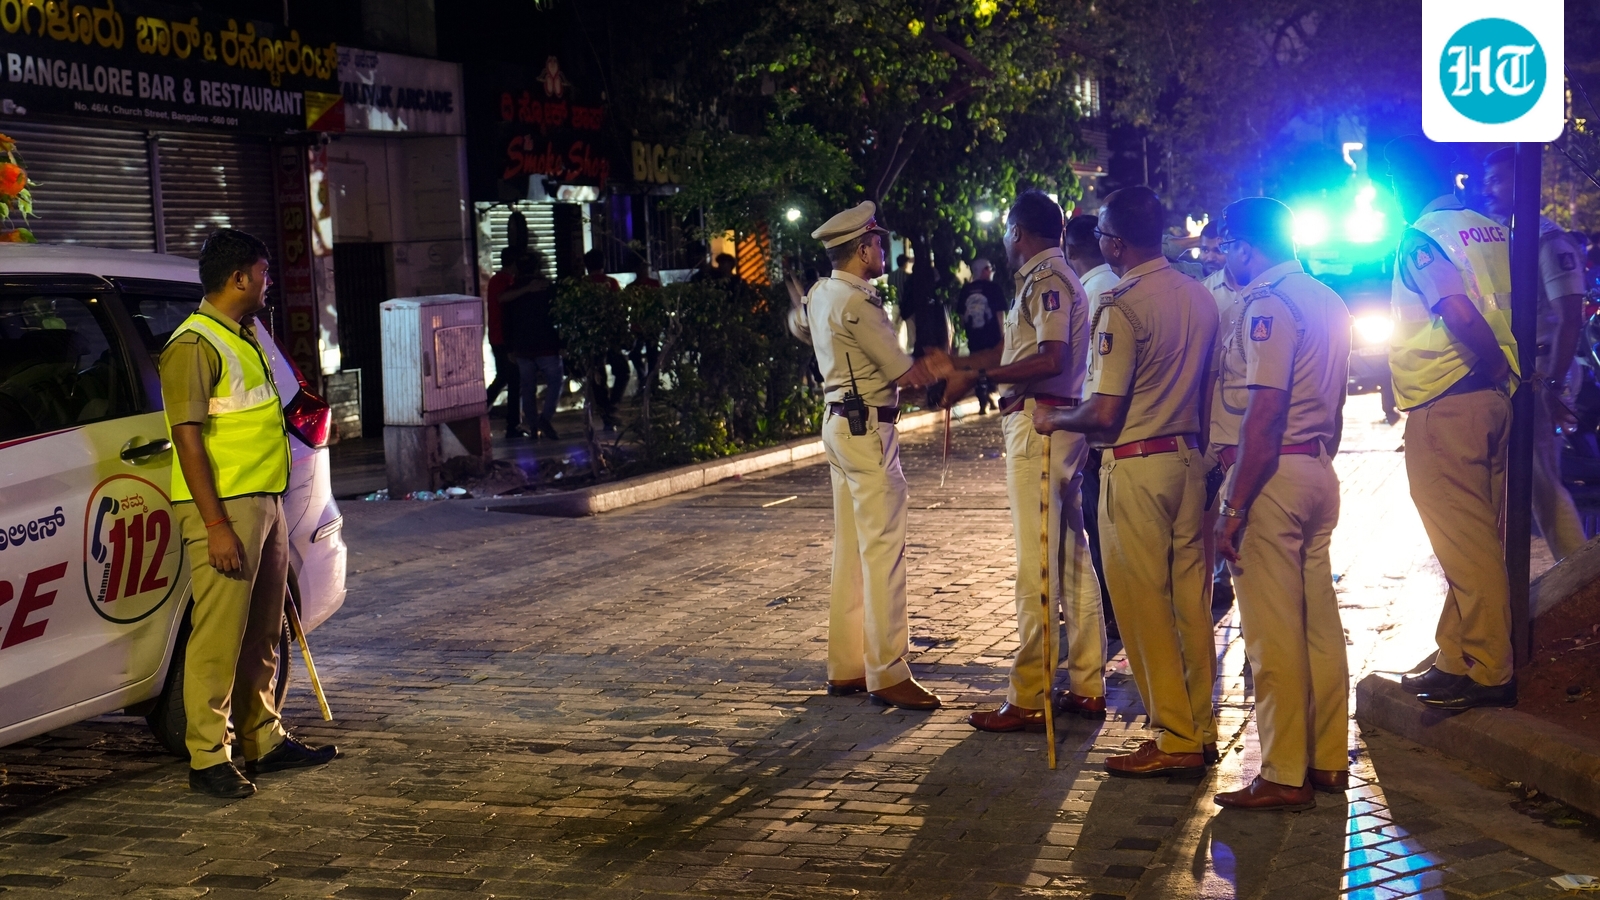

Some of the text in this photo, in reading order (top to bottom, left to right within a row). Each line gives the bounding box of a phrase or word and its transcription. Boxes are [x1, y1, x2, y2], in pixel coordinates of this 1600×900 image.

[0, 0, 126, 50] ಂಗಳೂರು
[134, 15, 200, 60] ಬಾರ್
[202, 31, 218, 62] &
[6, 52, 303, 116] BANGALORE BAR & RESTAURANT
[396, 87, 454, 114] ARCADE
[74, 101, 89, 111] No.
[112, 105, 143, 117] Church
[144, 107, 170, 120] Street,
[171, 111, 209, 123] Bangalore
[226, 117, 239, 126] 001
[502, 133, 611, 191] Smoke Shop
[1458, 226, 1506, 247] POLICE
[290, 312, 314, 380] BAR
[120, 493, 149, 514] ನಮ್ಮ
[0, 506, 66, 551] ಲೀಸ್
[103, 509, 171, 604] 112
[97, 562, 111, 602] Namma
